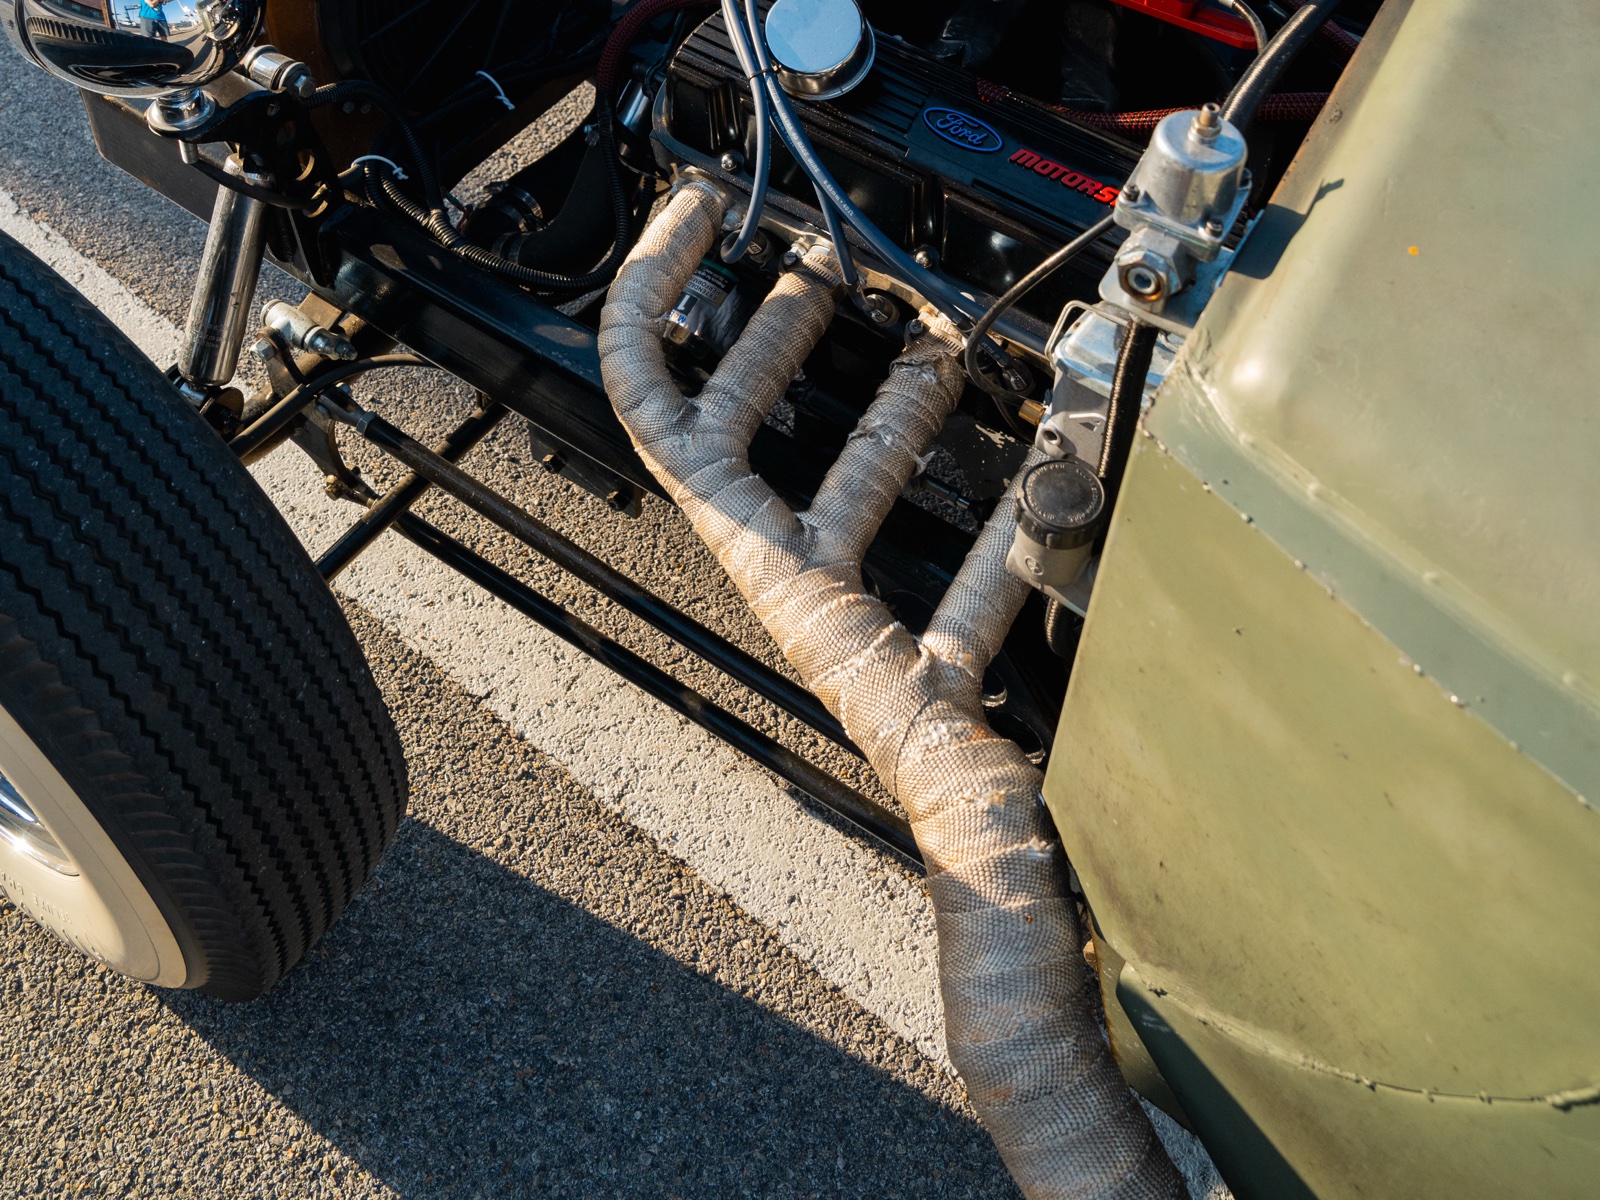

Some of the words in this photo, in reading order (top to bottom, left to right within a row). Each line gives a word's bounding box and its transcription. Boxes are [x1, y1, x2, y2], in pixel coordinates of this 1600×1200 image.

[936, 112, 988, 146] Ford
[1008, 148, 1120, 207] MOTORS
[676, 294, 690, 310] 1
[687, 281, 716, 301] EXTENDED
